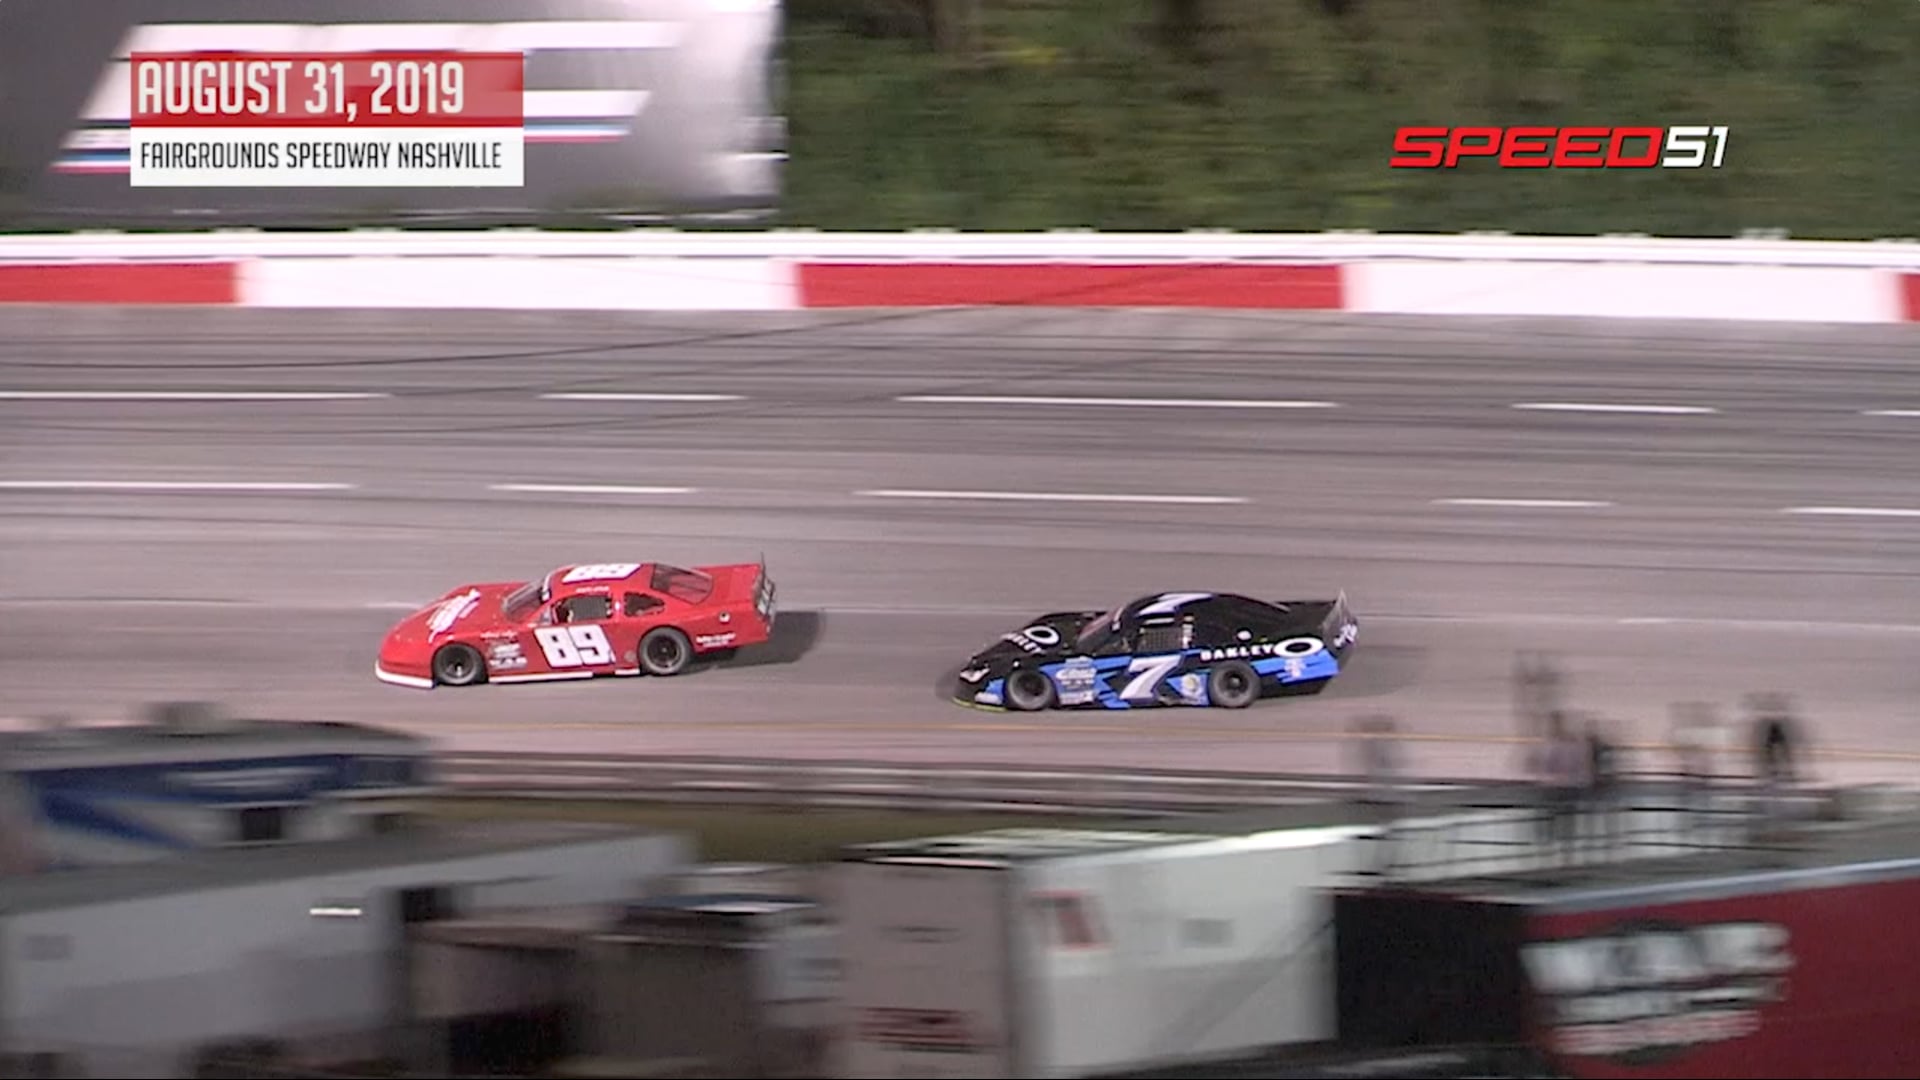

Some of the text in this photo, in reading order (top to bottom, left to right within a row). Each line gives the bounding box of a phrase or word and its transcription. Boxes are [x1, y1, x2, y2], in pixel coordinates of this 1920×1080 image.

[535, 625, 616, 668] 89
[1200, 644, 1274, 661] OAKLEY
[1120, 655, 1181, 699] 7
